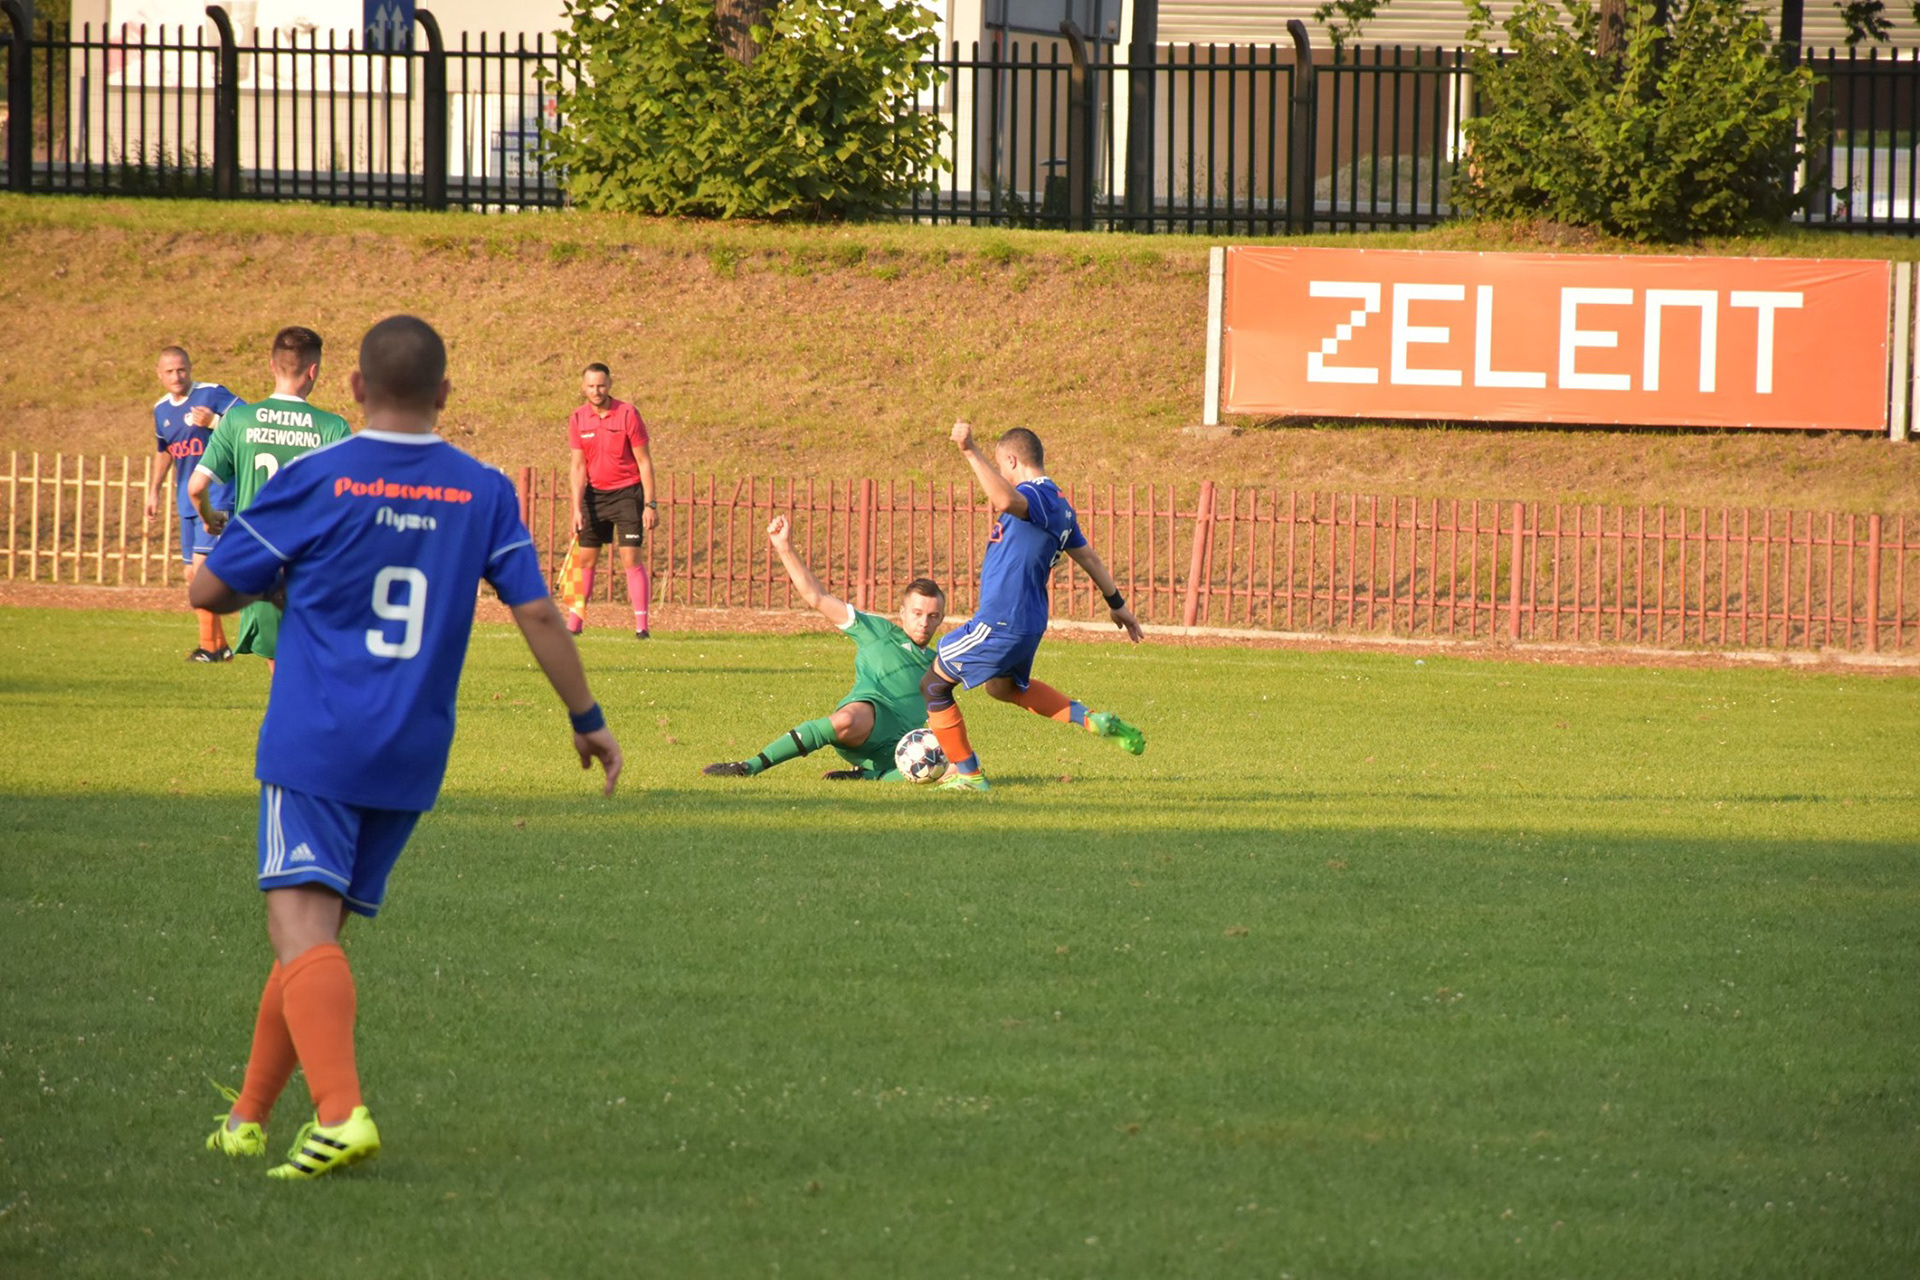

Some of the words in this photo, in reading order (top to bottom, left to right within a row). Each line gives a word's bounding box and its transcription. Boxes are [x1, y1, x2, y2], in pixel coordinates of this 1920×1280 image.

[1306, 281, 1805, 394] ZELENT
[246, 428, 321, 449] PRZEWORNO
[255, 408, 313, 428] GMINA
[367, 568, 428, 659] 9
